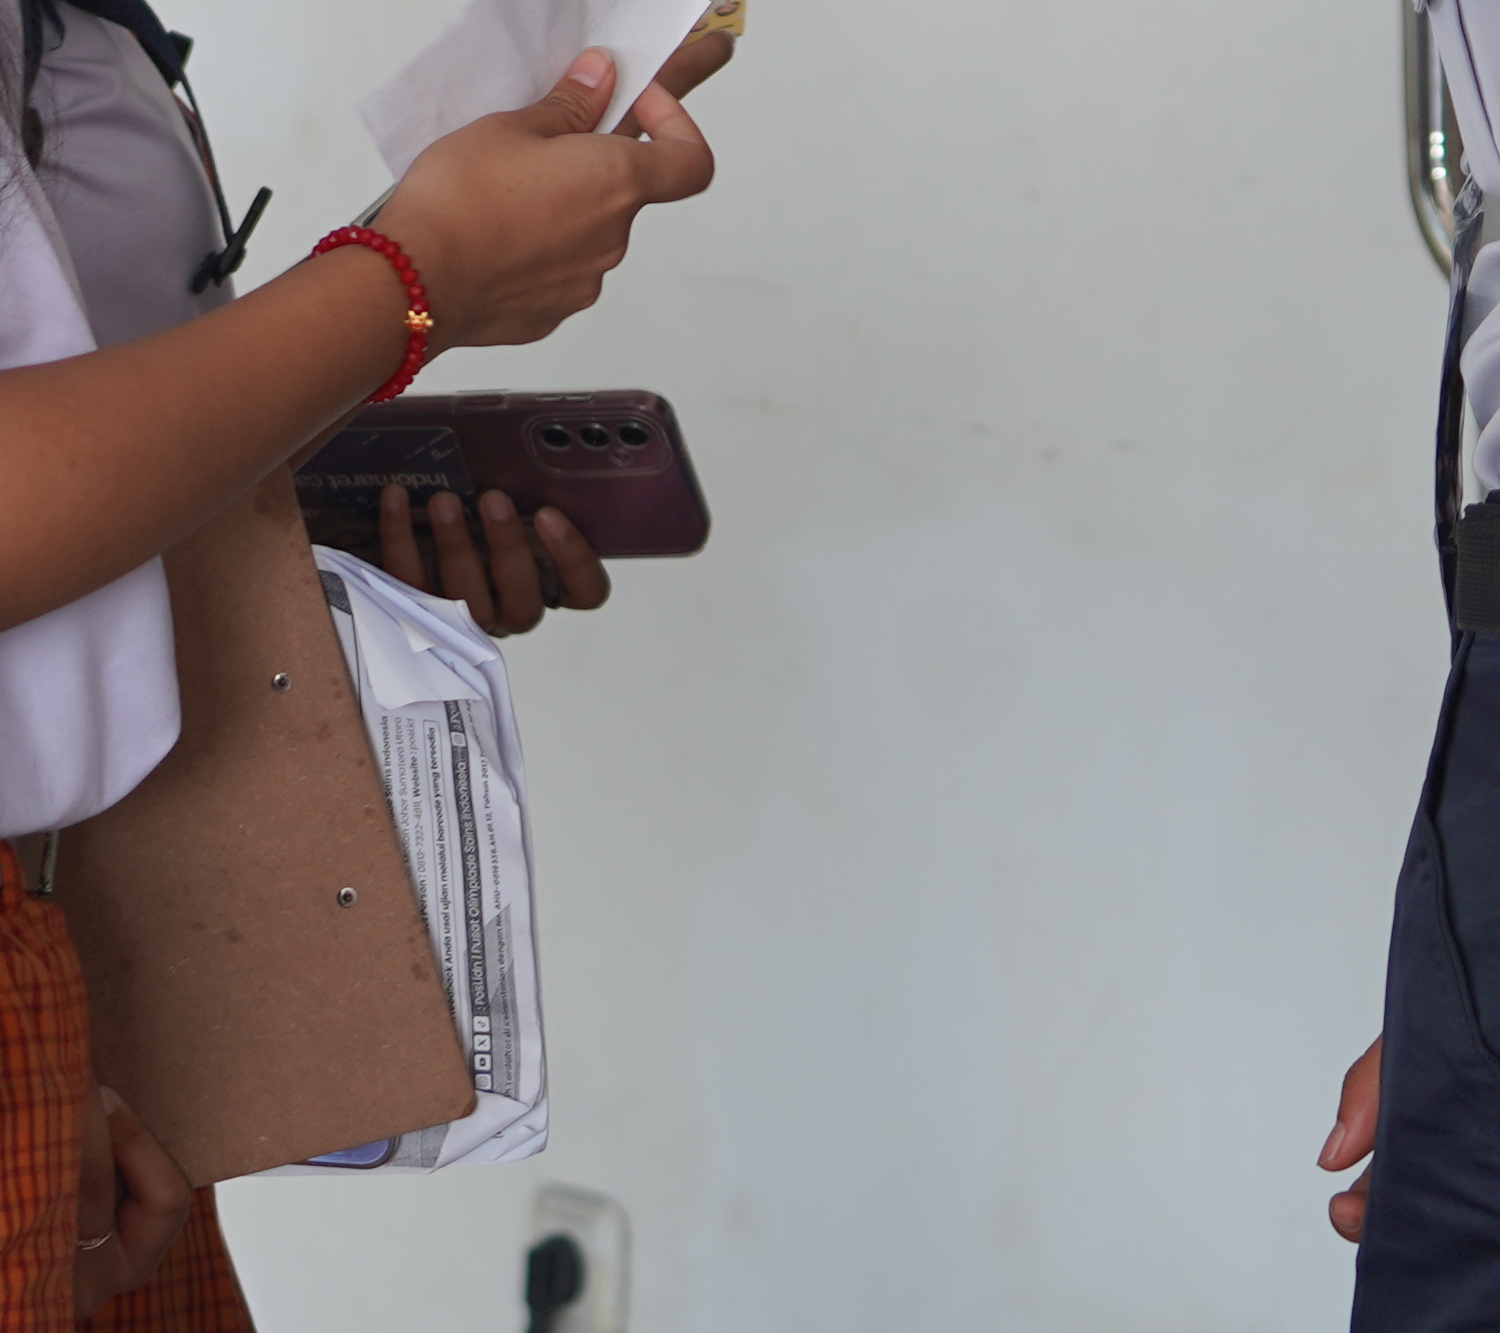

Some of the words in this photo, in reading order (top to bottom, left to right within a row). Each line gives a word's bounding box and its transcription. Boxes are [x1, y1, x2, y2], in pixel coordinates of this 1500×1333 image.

[326, 472, 450, 490] Indomaret
[378, 715, 392, 767] Indonesia
[426, 727, 438, 770] tersedia
[431, 771, 444, 798] yang
[456, 761, 473, 820] Indonesia
[433, 799, 446, 842] barcode
[461, 820, 477, 853] Sains
[436, 843, 449, 882] melalui
[439, 883, 453, 910] ujian
[463, 854, 481, 918] Olimpiade
[442, 936, 455, 964] Anda
[468, 920, 482, 954] Pusat
